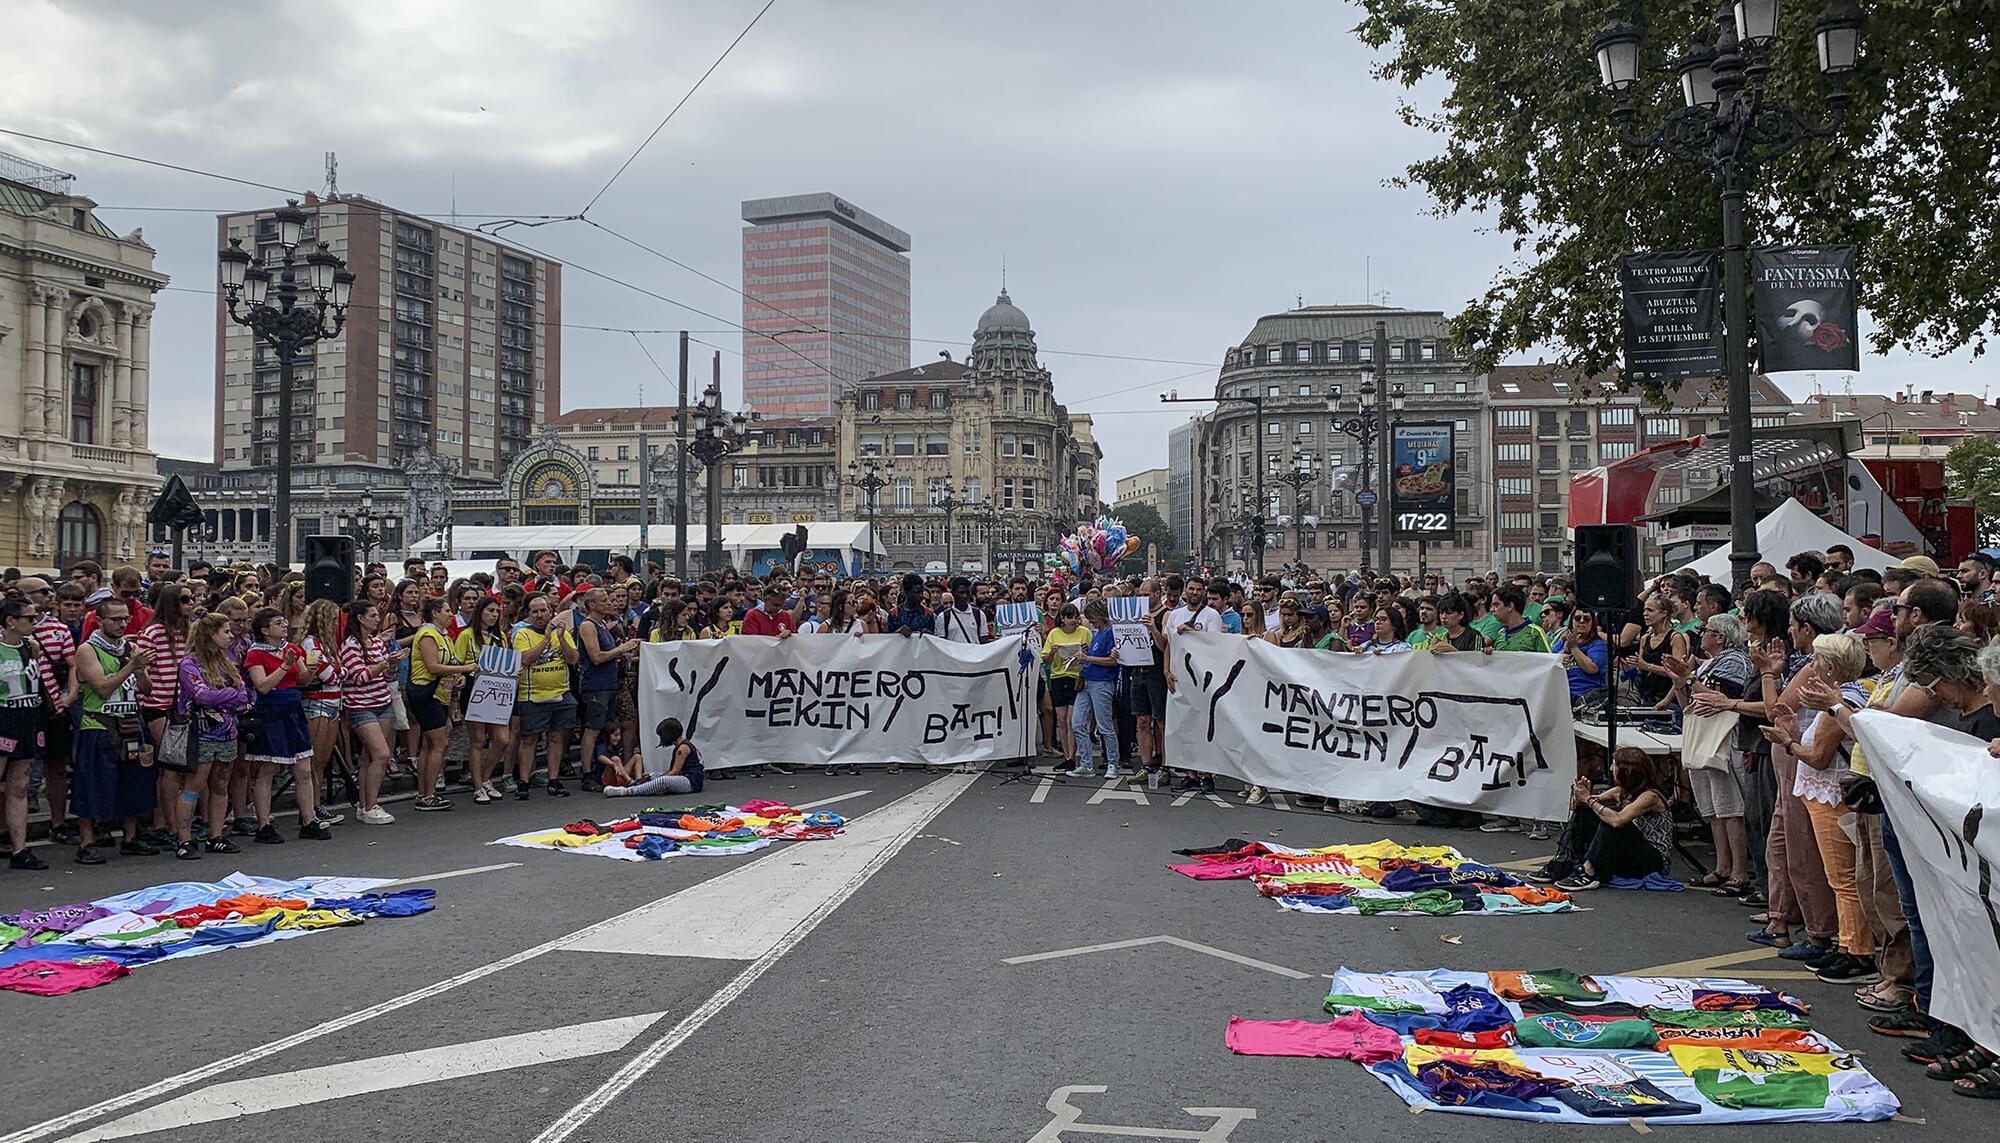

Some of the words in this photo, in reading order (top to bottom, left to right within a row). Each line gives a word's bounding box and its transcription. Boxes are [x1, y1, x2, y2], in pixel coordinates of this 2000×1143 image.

[1631, 267, 1667, 276] TEATRO
[1670, 265, 1710, 274] ARRIAGA
[1764, 268, 1851, 281] FANTASMA
[1648, 275, 1695, 285] ANTZOKIA
[1771, 281, 1785, 289] DE
[1808, 279, 1844, 288] ÓPERA
[1646, 297, 1696, 307] ABUZTUAK
[1648, 308, 1657, 316] 14
[1660, 306, 1698, 315] AGOSTO
[1654, 323, 1694, 333] IRAILAK
[1638, 335, 1647, 344] 15
[1649, 332, 1711, 343] SEPTIEMBRE
[1417, 449, 1427, 467] 9
[1398, 513, 1448, 531] 17:22
[747, 668, 926, 700] MANTERO
[471, 687, 513, 707] BAT!
[1264, 680, 1439, 730] MANTERO
[745, 697, 871, 731] -EKIN
[923, 703, 1004, 744] BAT!
[1261, 715, 1389, 762] -EKIN
[1427, 734, 1528, 791] BAT!
